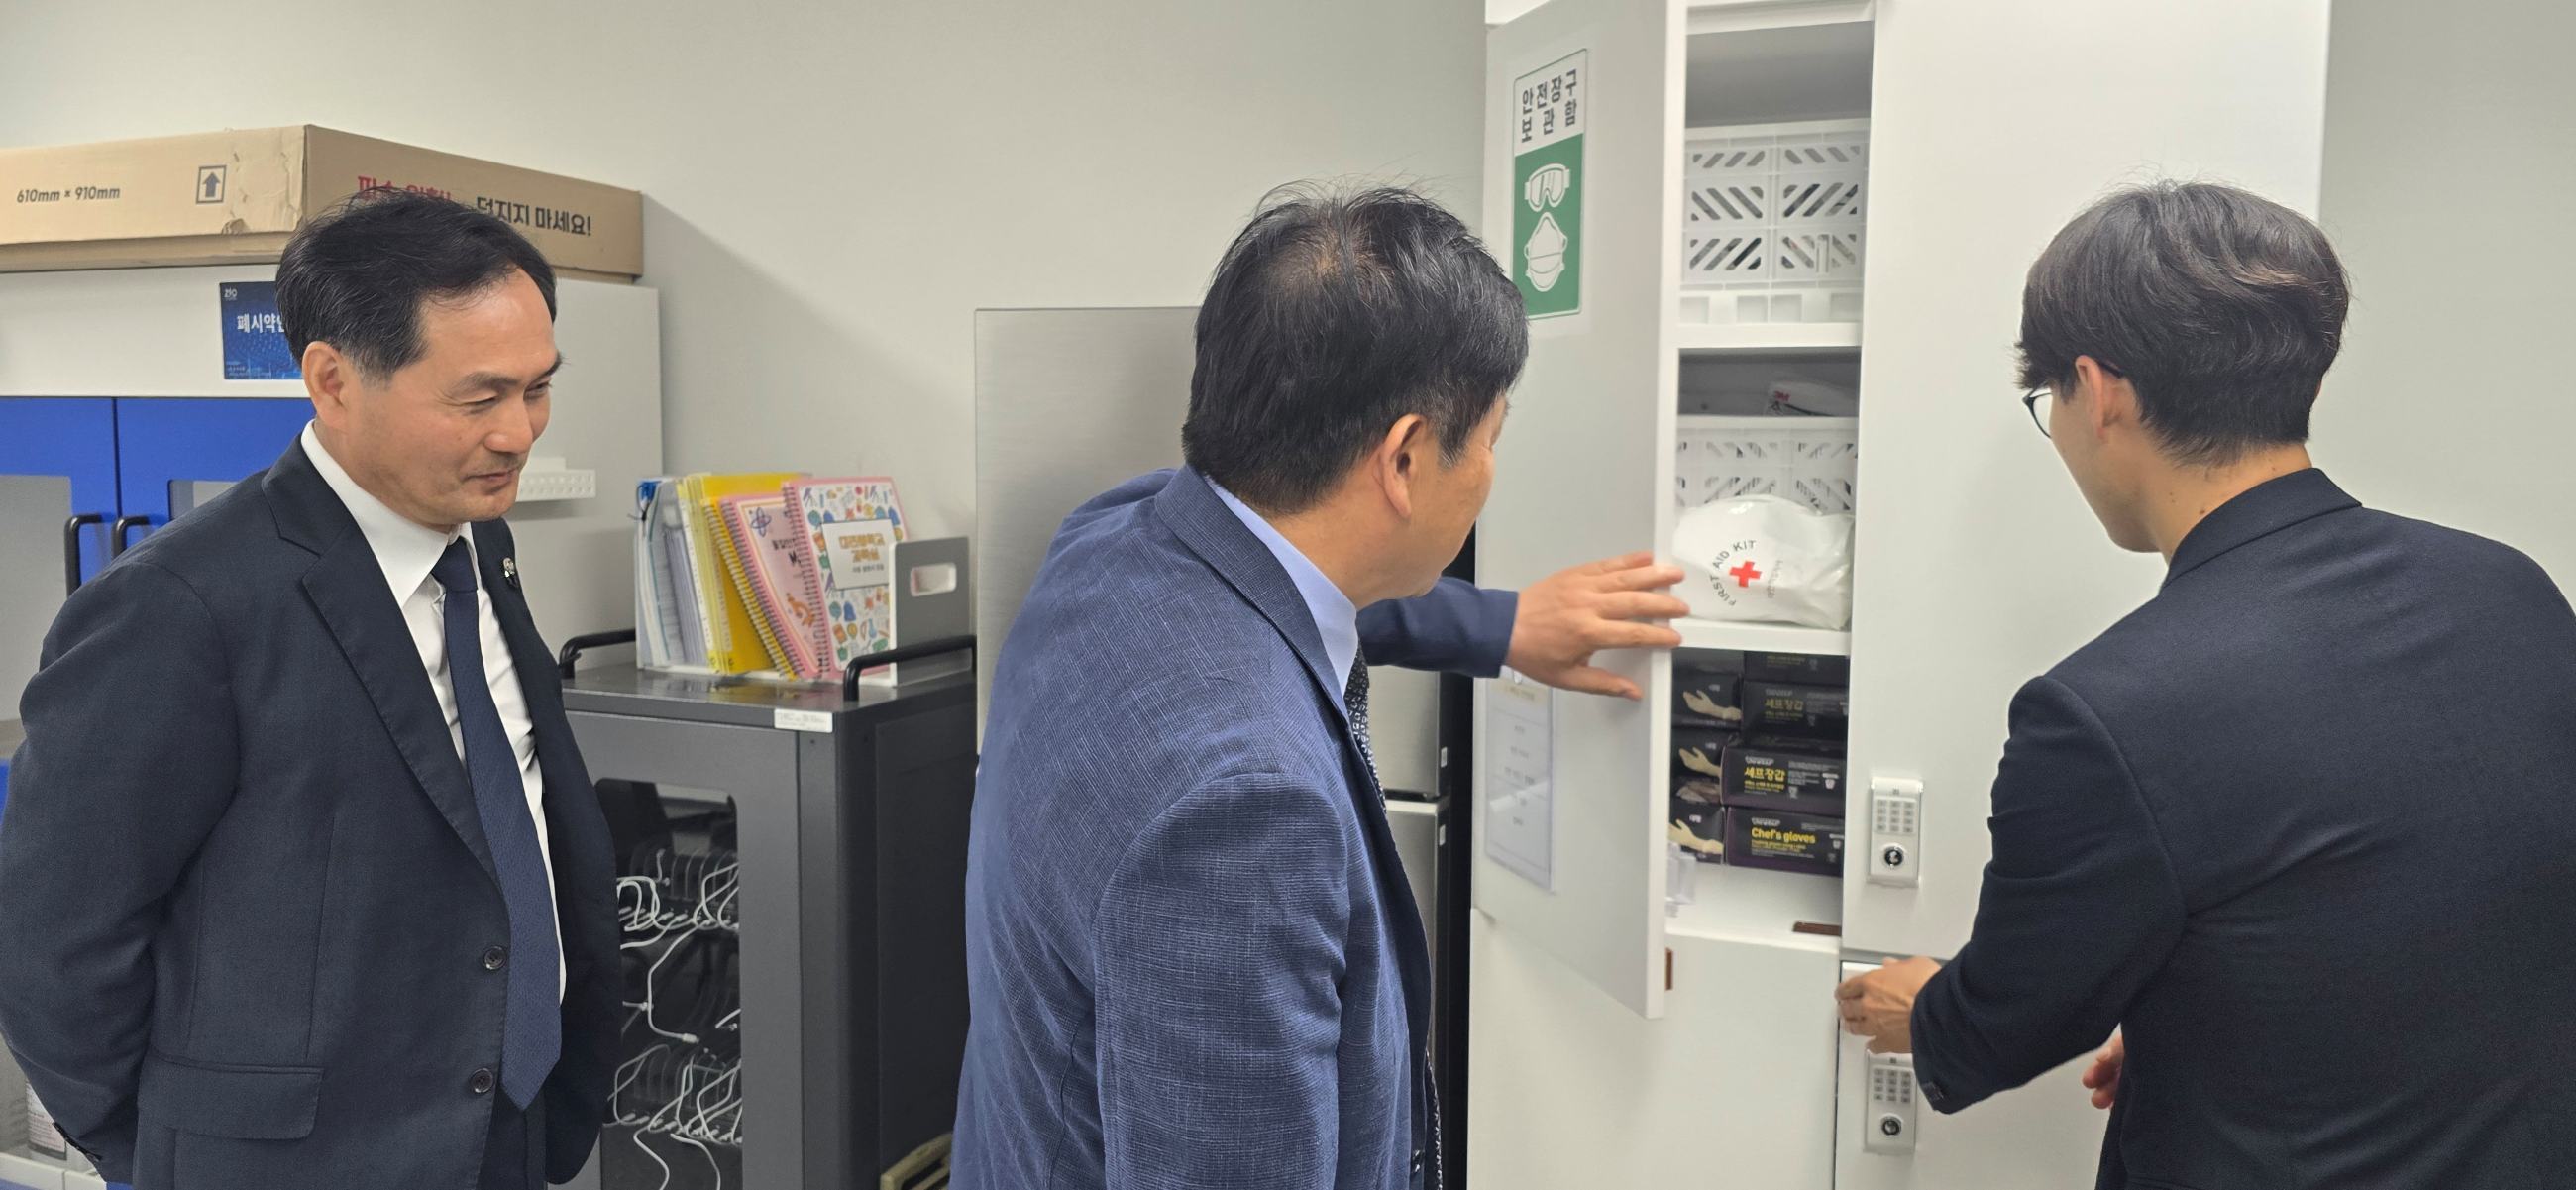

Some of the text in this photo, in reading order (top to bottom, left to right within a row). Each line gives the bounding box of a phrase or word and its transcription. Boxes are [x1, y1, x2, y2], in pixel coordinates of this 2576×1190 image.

[1522, 68, 1576, 115] 안전장구
[1521, 98, 1577, 144] 보관함
[16, 189, 60, 203] 610mm
[75, 186, 121, 200] 910mm
[535, 207, 591, 236] 마세요!
[1712, 550, 1730, 569] AID
[1732, 539, 1758, 552] KIT
[1751, 826, 1817, 845] Chef's gloves
